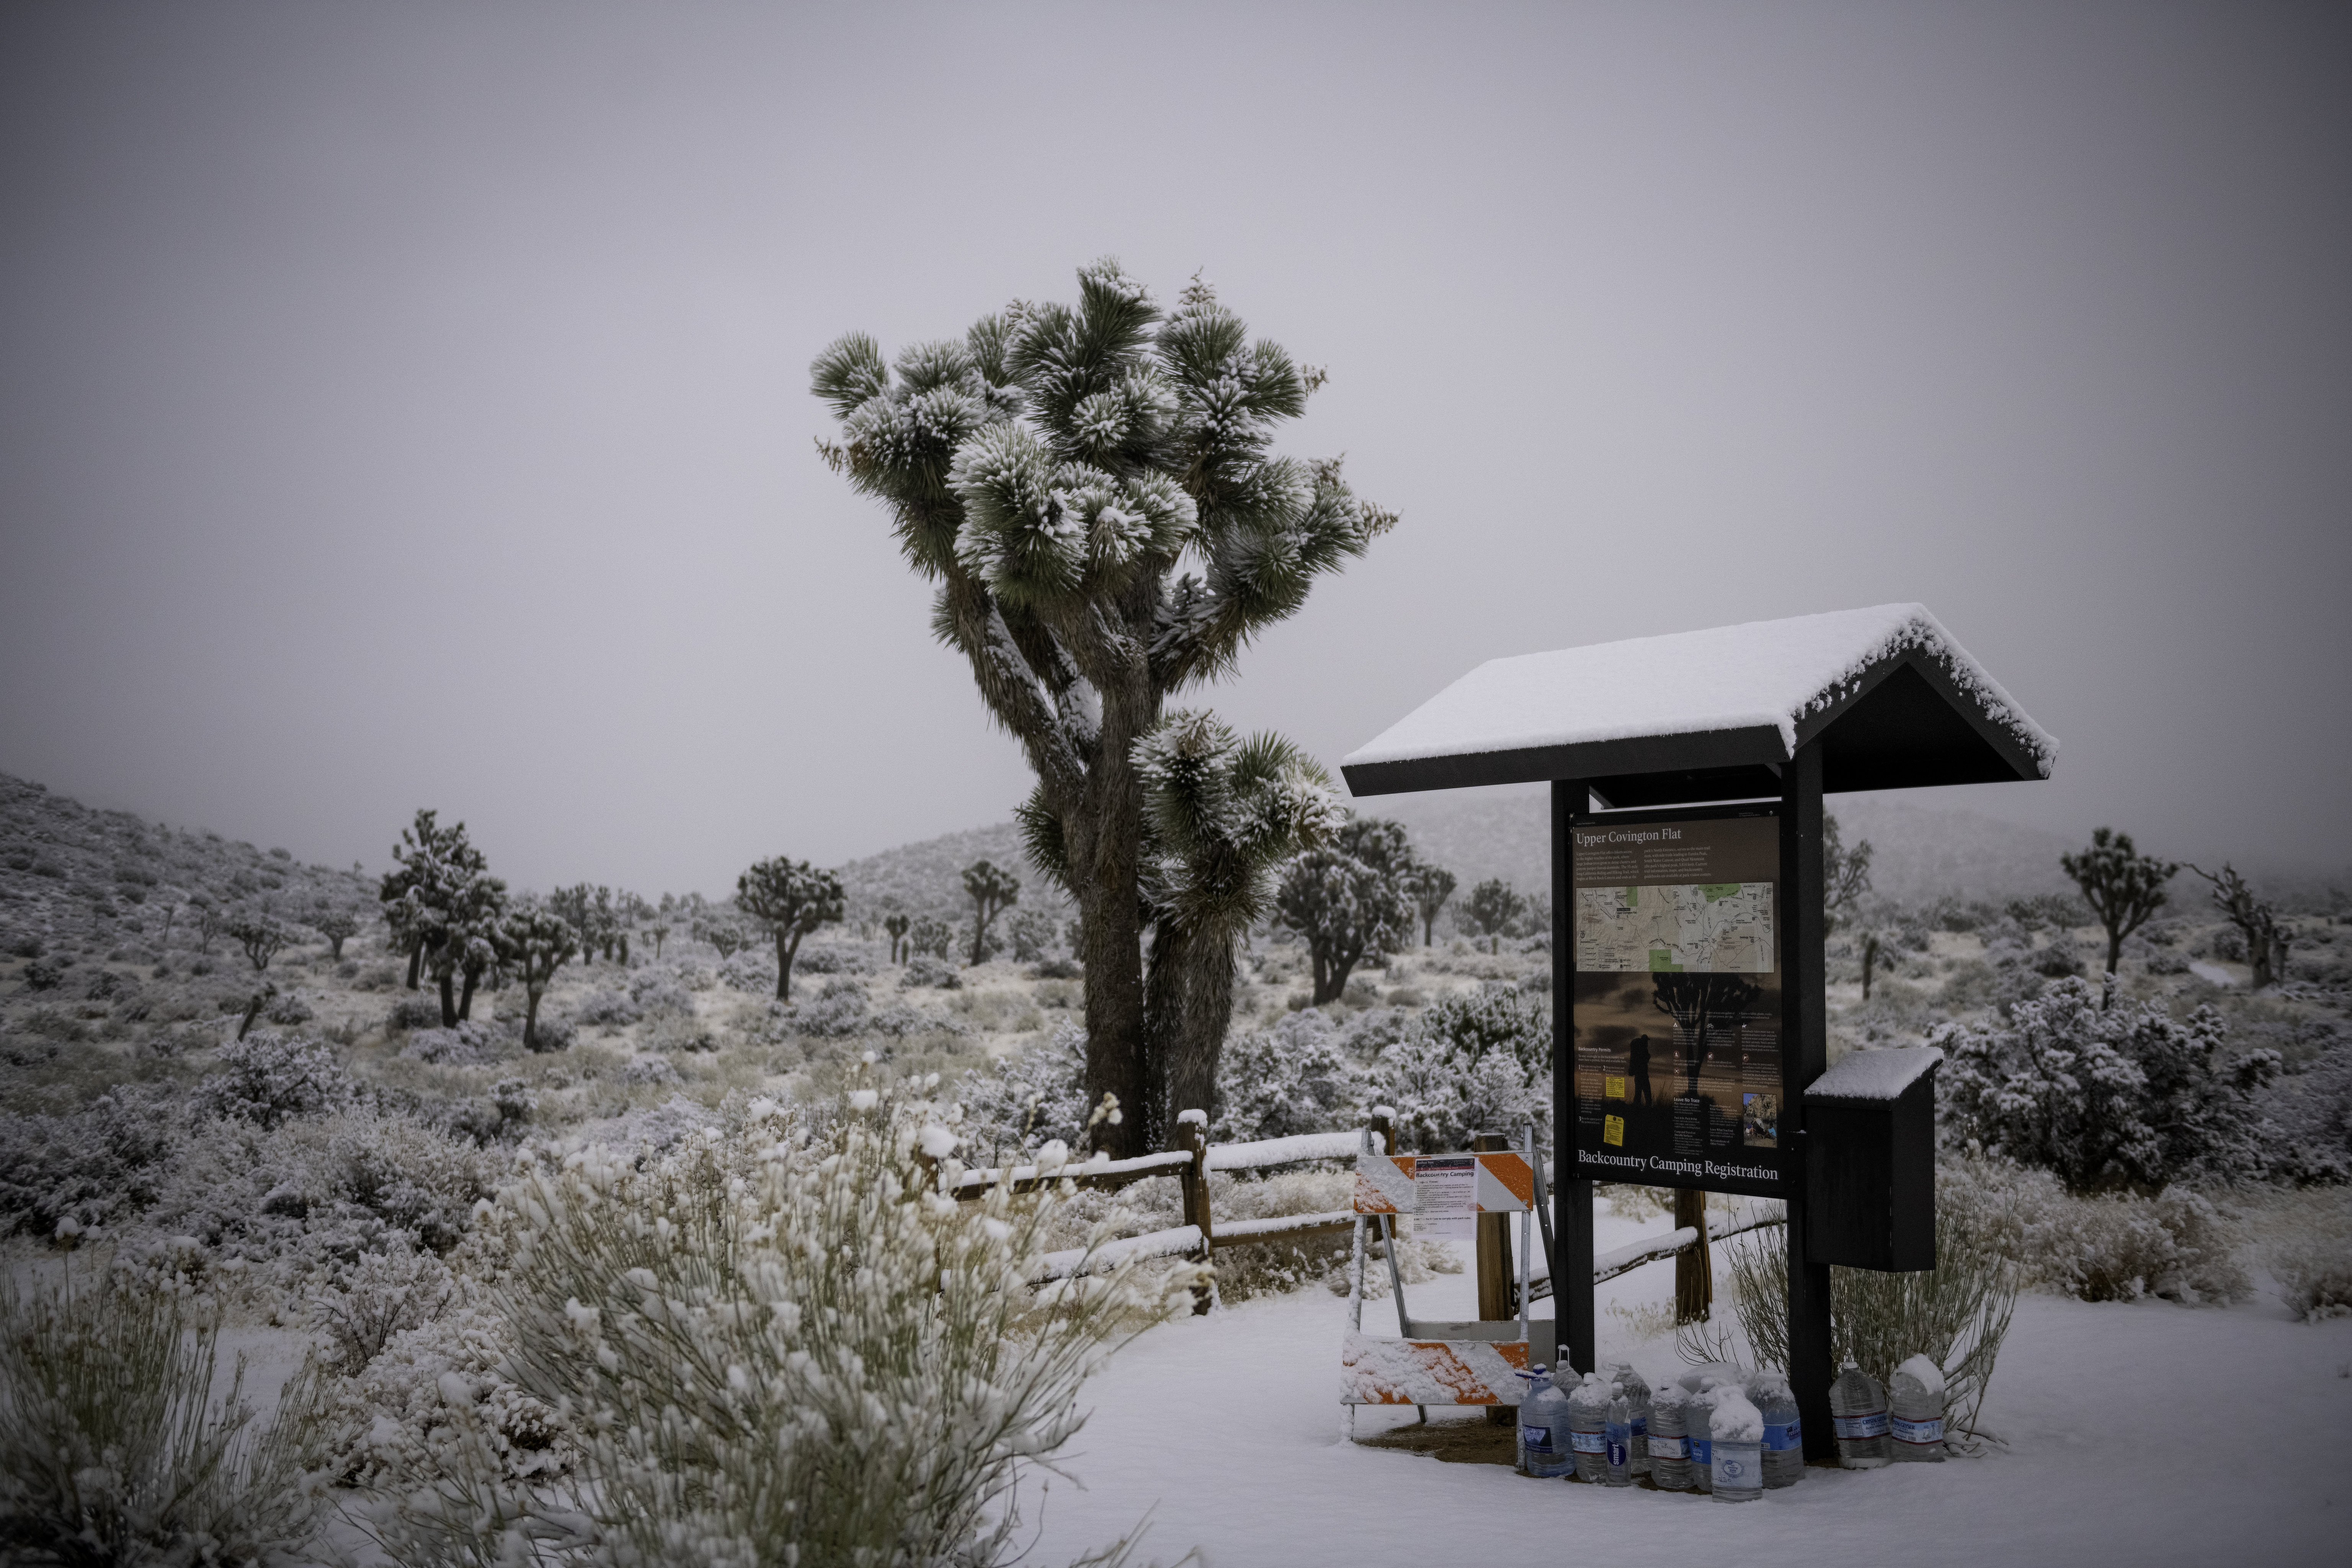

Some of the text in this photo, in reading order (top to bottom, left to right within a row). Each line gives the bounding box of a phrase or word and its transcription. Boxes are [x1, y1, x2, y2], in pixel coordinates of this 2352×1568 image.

[1576, 828, 1681, 846] Upper Covington Flat
[1578, 1150, 1778, 1179] Backcountry Camping Registration
